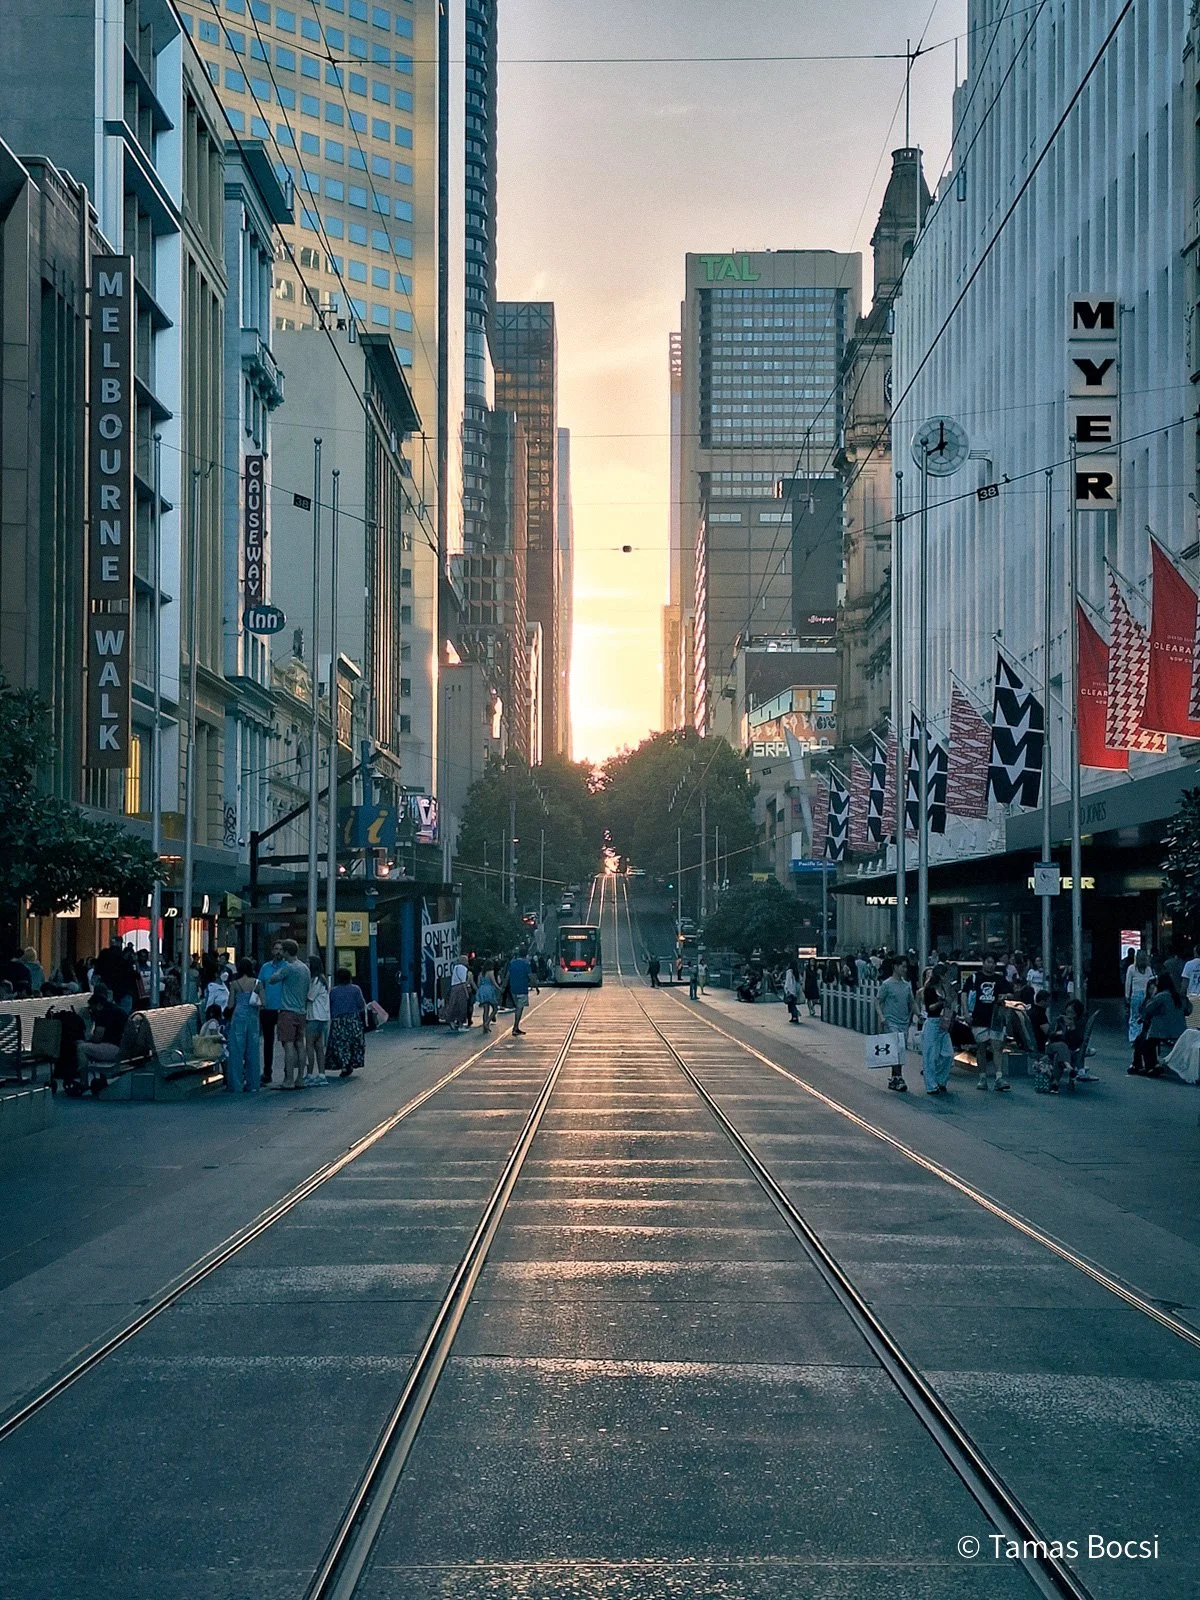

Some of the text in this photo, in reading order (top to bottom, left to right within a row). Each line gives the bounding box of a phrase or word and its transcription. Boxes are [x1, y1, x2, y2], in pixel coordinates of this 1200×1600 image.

[700, 256, 760, 281] TAL
[1072, 302, 1116, 500] MYER
[980, 487, 997, 499] 38
[95, 272, 125, 750] MELBOURNE WALK
[247, 461, 278, 629] CAUSEWAY Inn
[164, 907, 178, 918] JD
[425, 928, 450, 947] ONLY
